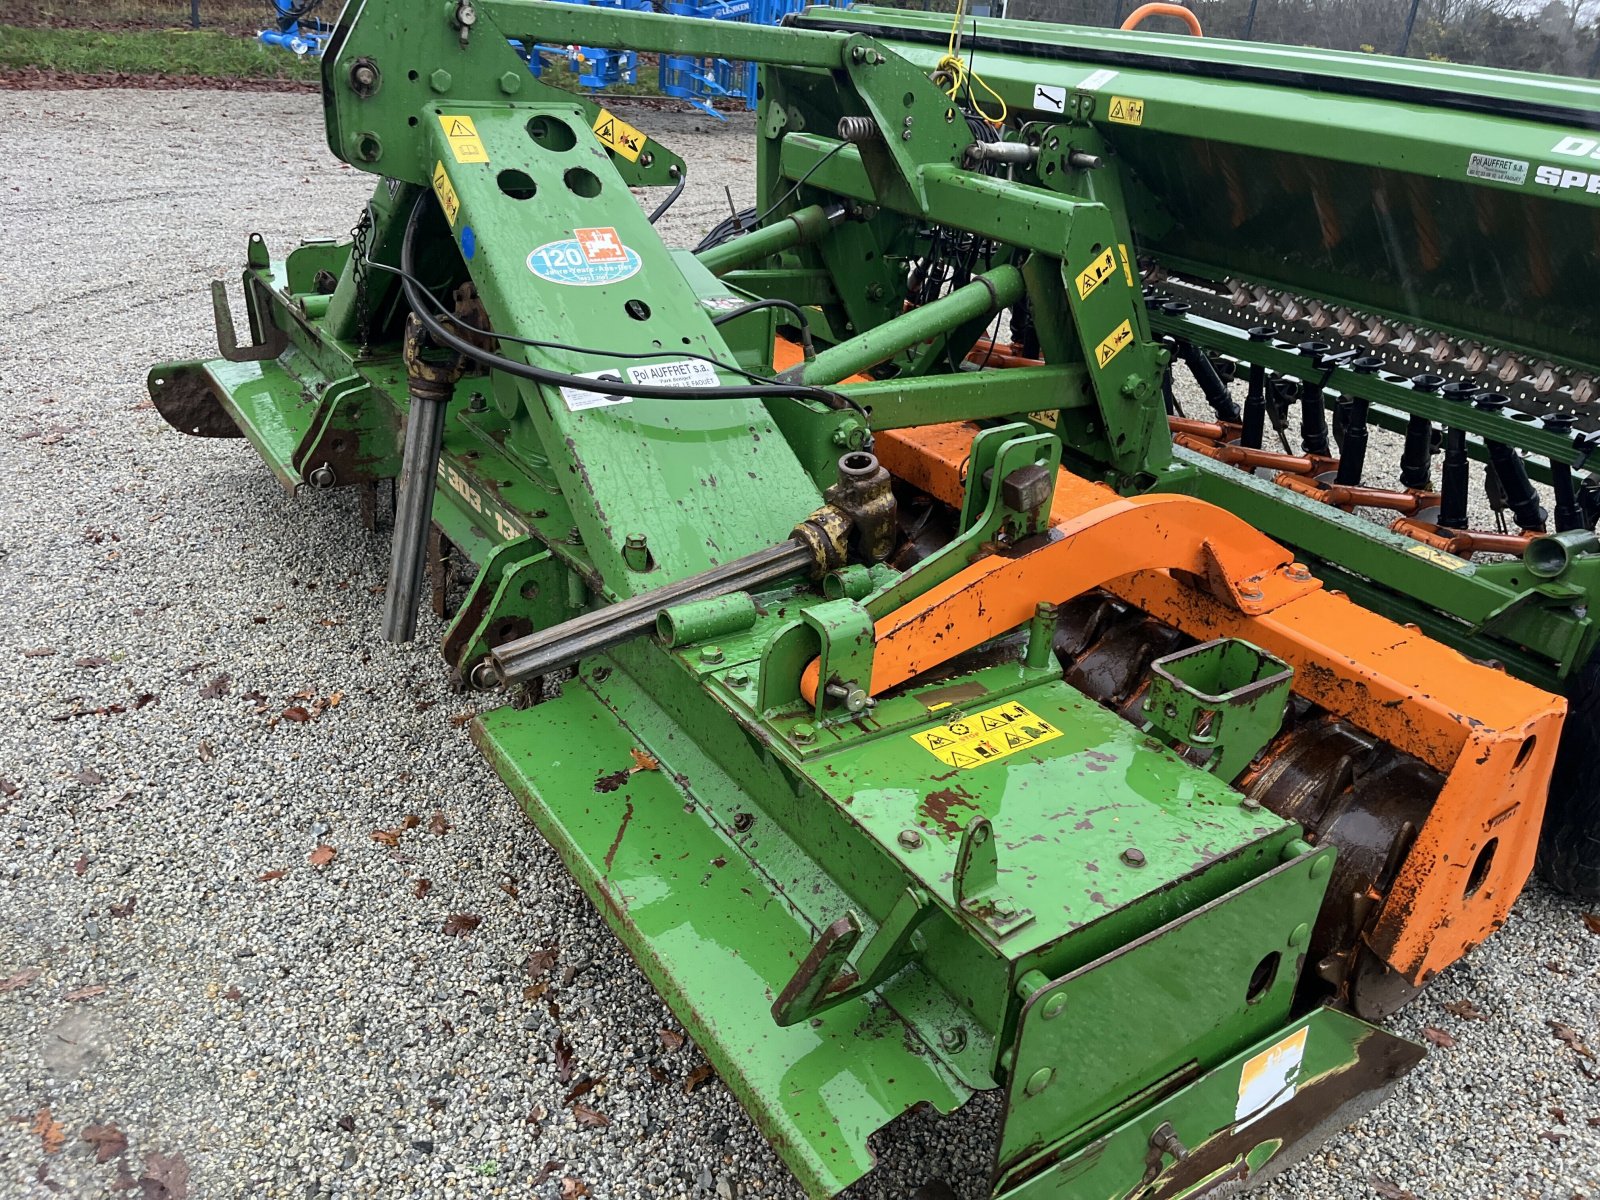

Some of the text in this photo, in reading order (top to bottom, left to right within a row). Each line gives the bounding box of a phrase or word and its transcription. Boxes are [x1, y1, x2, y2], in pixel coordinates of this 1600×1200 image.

[1551, 136, 1600, 160] D
[1483, 158, 1513, 170] AUFFRET
[538, 248, 582, 267] 120
[633, 364, 709, 381] Pol AUFFRET s.a.
[448, 466, 481, 513] 303
